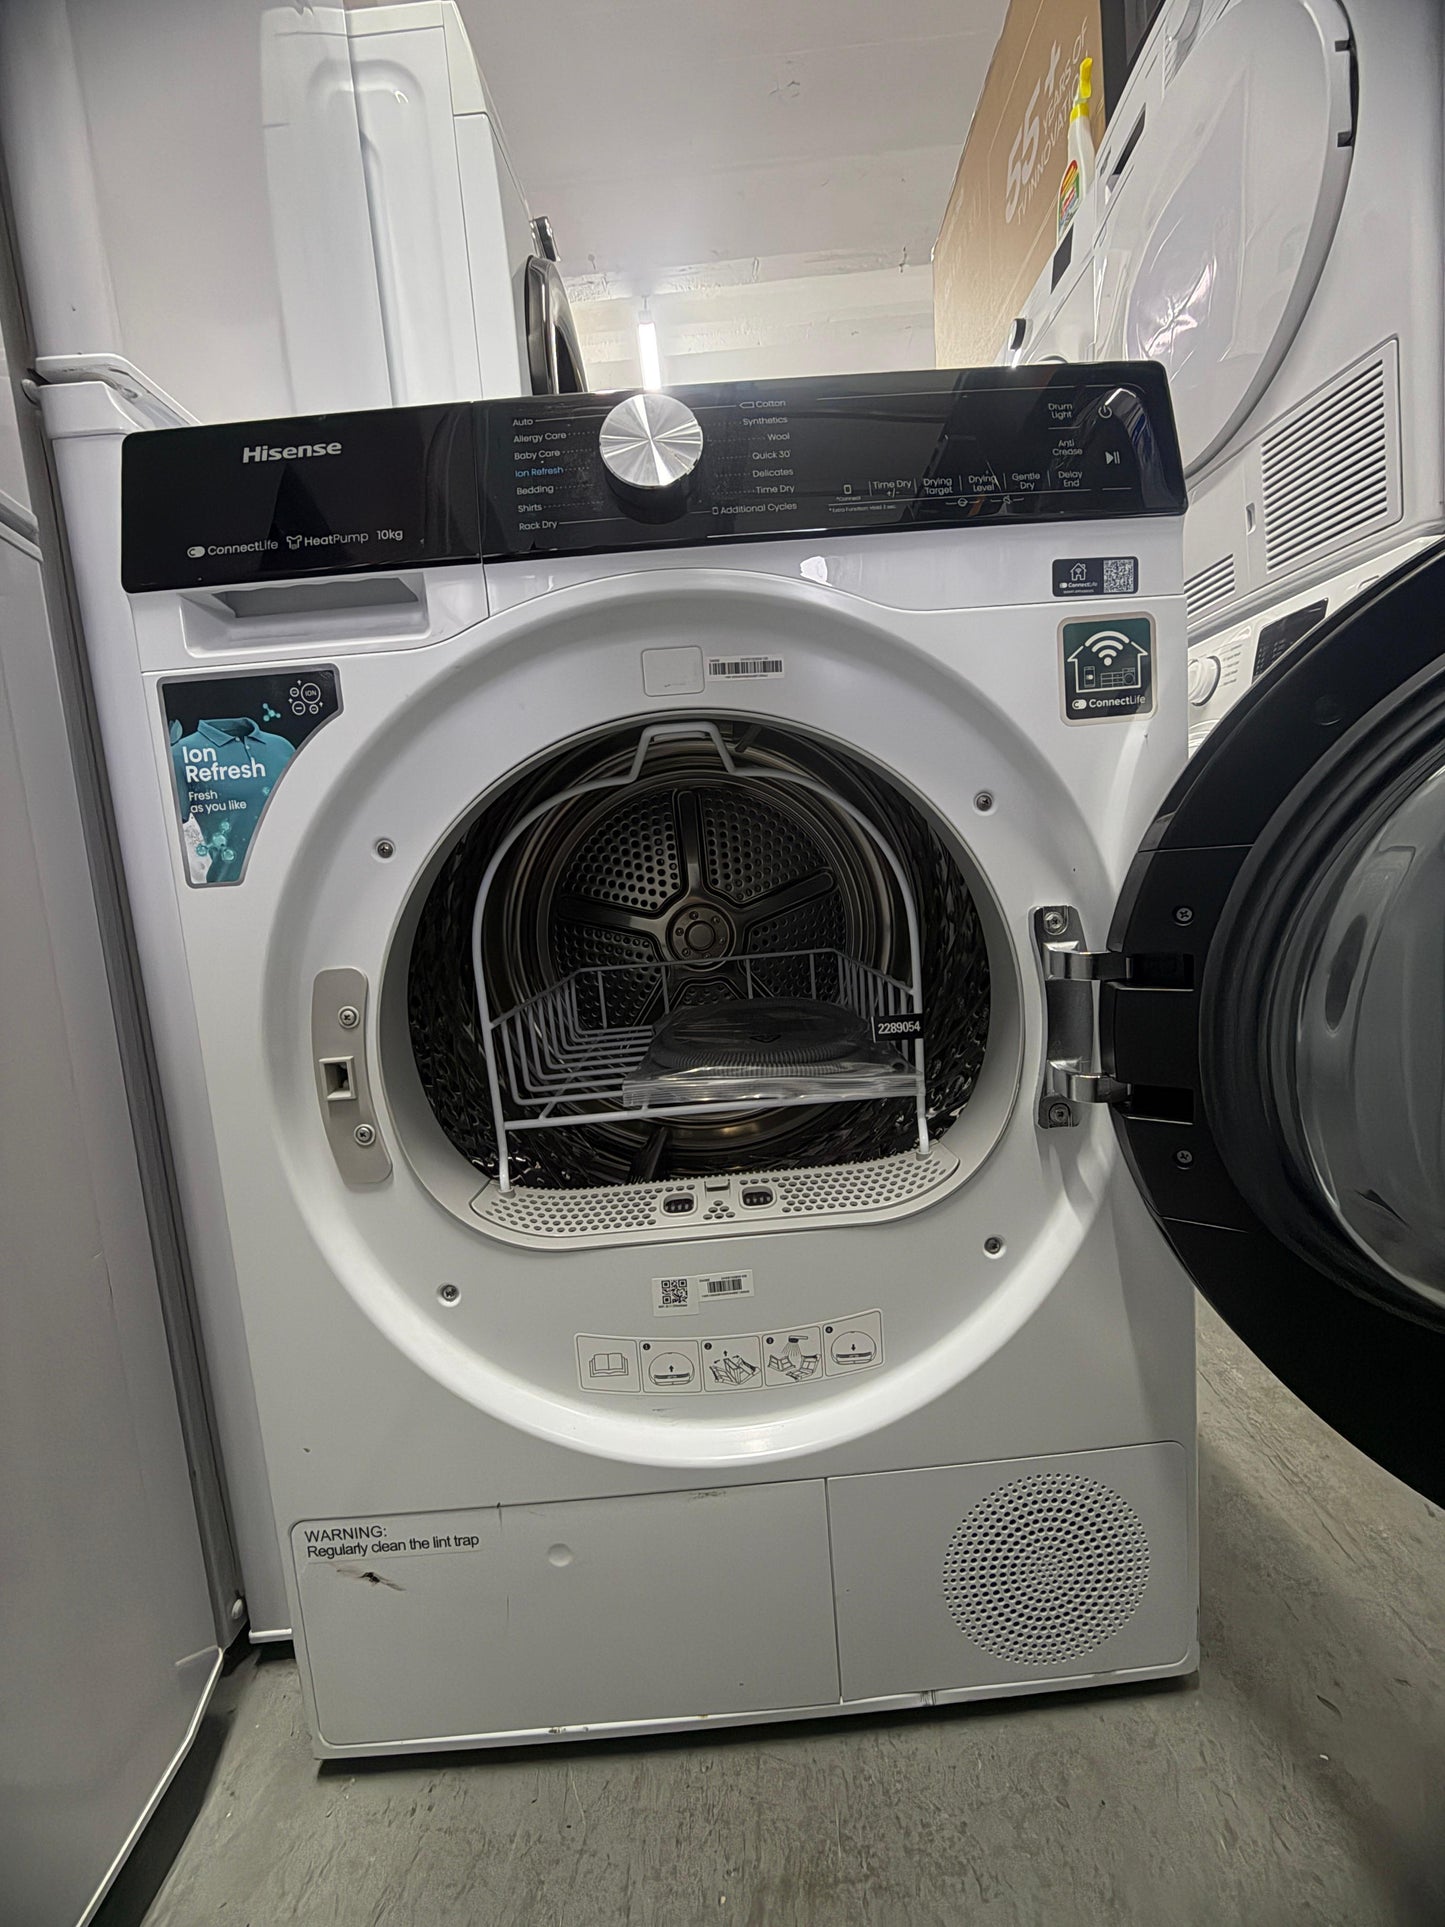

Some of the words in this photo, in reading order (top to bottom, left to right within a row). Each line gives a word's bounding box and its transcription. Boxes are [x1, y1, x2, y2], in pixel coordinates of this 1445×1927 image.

[755, 400, 786, 408] Cotton
[1051, 411, 1072, 420] Light
[513, 418, 533, 427] Auto
[743, 416, 788, 427] Synthetics
[513, 433, 543, 444] Allergy
[545, 432, 567, 440] Care
[767, 432, 790, 441] Wool
[1058, 439, 1074, 447] Anti
[242, 441, 342, 463] Hisense
[514, 451, 537, 461] Baby
[538, 450, 561, 458] Care
[752, 451, 777, 460] Quick
[1052, 447, 1082, 456] Crease
[515, 469, 530, 477] Ion
[531, 466, 564, 476] Refresh
[752, 468, 793, 478] Delicates
[1011, 472, 1040, 481] Gentle
[1058, 470, 1083, 480] Delay
[923, 477, 952, 487] Drying
[968, 474, 996, 484] Drying
[1063, 479, 1080, 487] End
[755, 485, 778, 494] Time
[779, 484, 795, 493] Dry
[873, 481, 895, 490] Time
[896, 479, 911, 488] Dry
[973, 484, 995, 492] Level
[1020, 481, 1035, 490] Dry
[516, 485, 554, 495] Bedding
[925, 486, 953, 495] Target
[518, 503, 542, 513] Shirts
[720, 504, 765, 514] Additional
[767, 502, 797, 512] Cycles
[519, 521, 541, 530] Rack
[542, 519, 558, 529] Dry
[304, 532, 369, 547] HeatPump
[376, 529, 403, 541] 10kg
[207, 540, 279, 556] ConnectLife
[305, 689, 317, 697] ION
[1089, 695, 1146, 708] ConnectLife
[182, 745, 217, 764] Ion
[185, 757, 266, 783] Refresh
[188, 790, 218, 801] Fresh
[190, 803, 204, 813] as
[205, 801, 227, 814] you
[228, 799, 247, 811] like
[878, 1020, 921, 1034] 2289054
[304, 1525, 387, 1543] WARNING:
[307, 1543, 369, 1560] Regularly
[371, 1539, 406, 1554] clean
[409, 1538, 430, 1550] the
[432, 1536, 452, 1548] lint
[454, 1535, 480, 1548] trap
